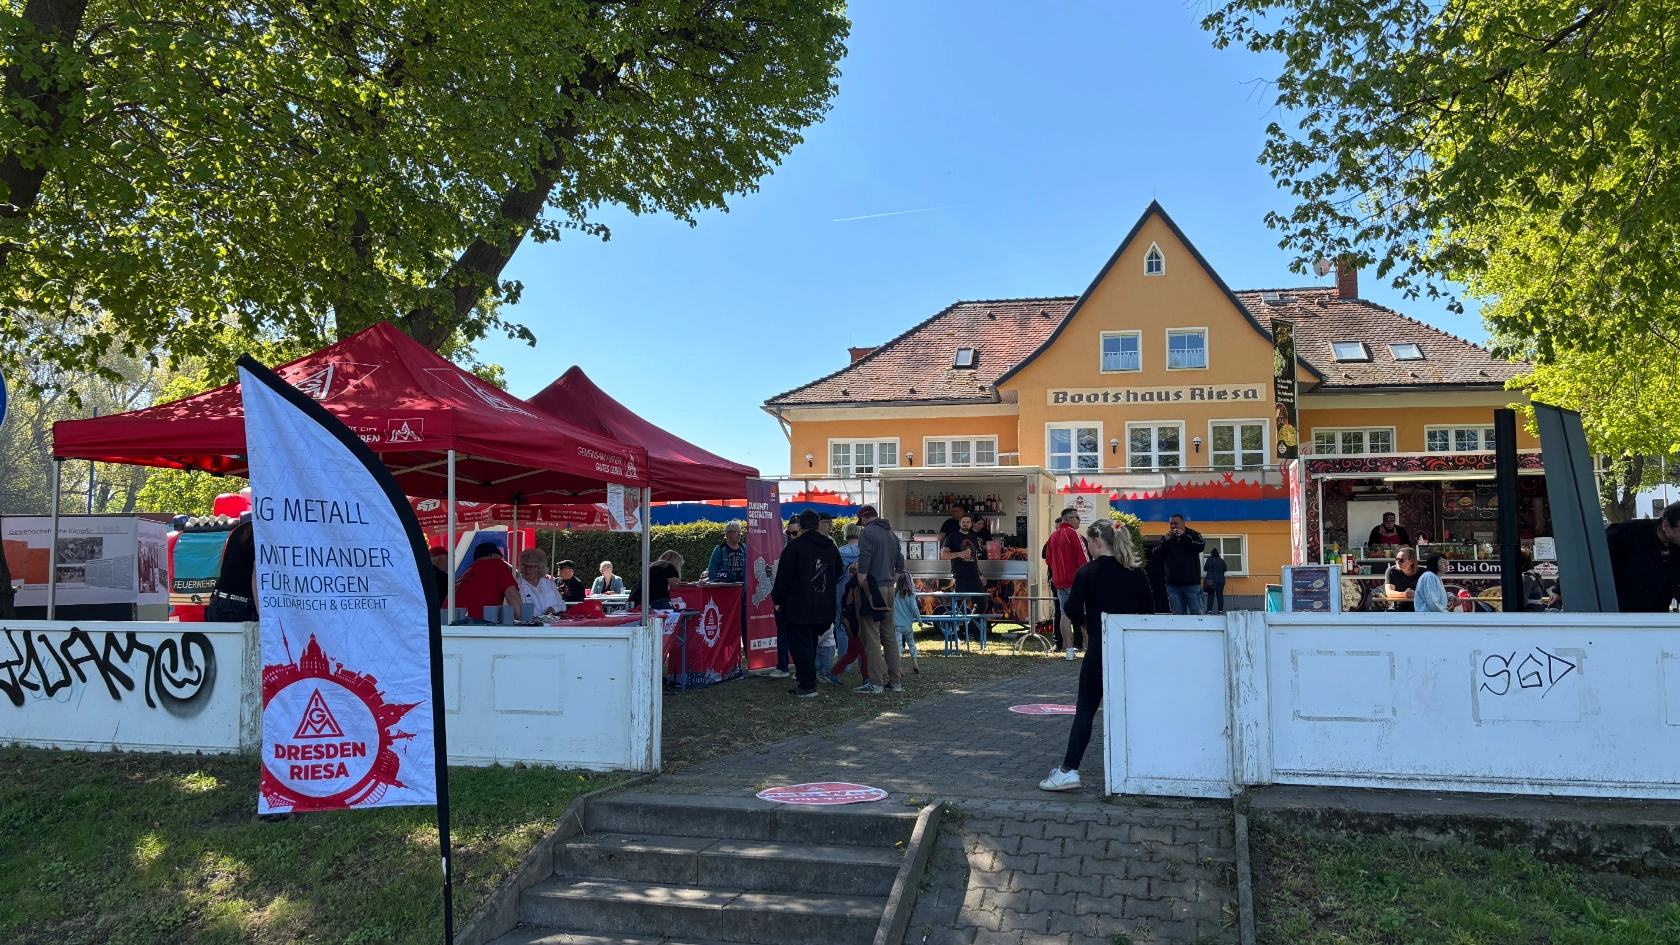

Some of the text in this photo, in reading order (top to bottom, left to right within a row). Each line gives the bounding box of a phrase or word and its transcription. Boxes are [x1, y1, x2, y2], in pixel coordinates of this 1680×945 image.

[1052, 389, 1185, 405] Bootshaus
[1189, 386, 1260, 401] Riesa
[254, 496, 370, 525] IG METALL
[748, 502, 769, 511] ZUKUNFT
[748, 510, 773, 519] GESTALTEN
[260, 543, 394, 568] MITEINANDER
[1457, 562, 1477, 573] bei
[1479, 562, 1501, 573] Om
[261, 570, 369, 594] FÜR MORGEN
[263, 596, 327, 611] SOLIDARISCH
[330, 600, 338, 611] &
[340, 598, 388, 610] GERECHT
[274, 742, 366, 761] DRESDEN
[289, 762, 350, 781] RIESA
